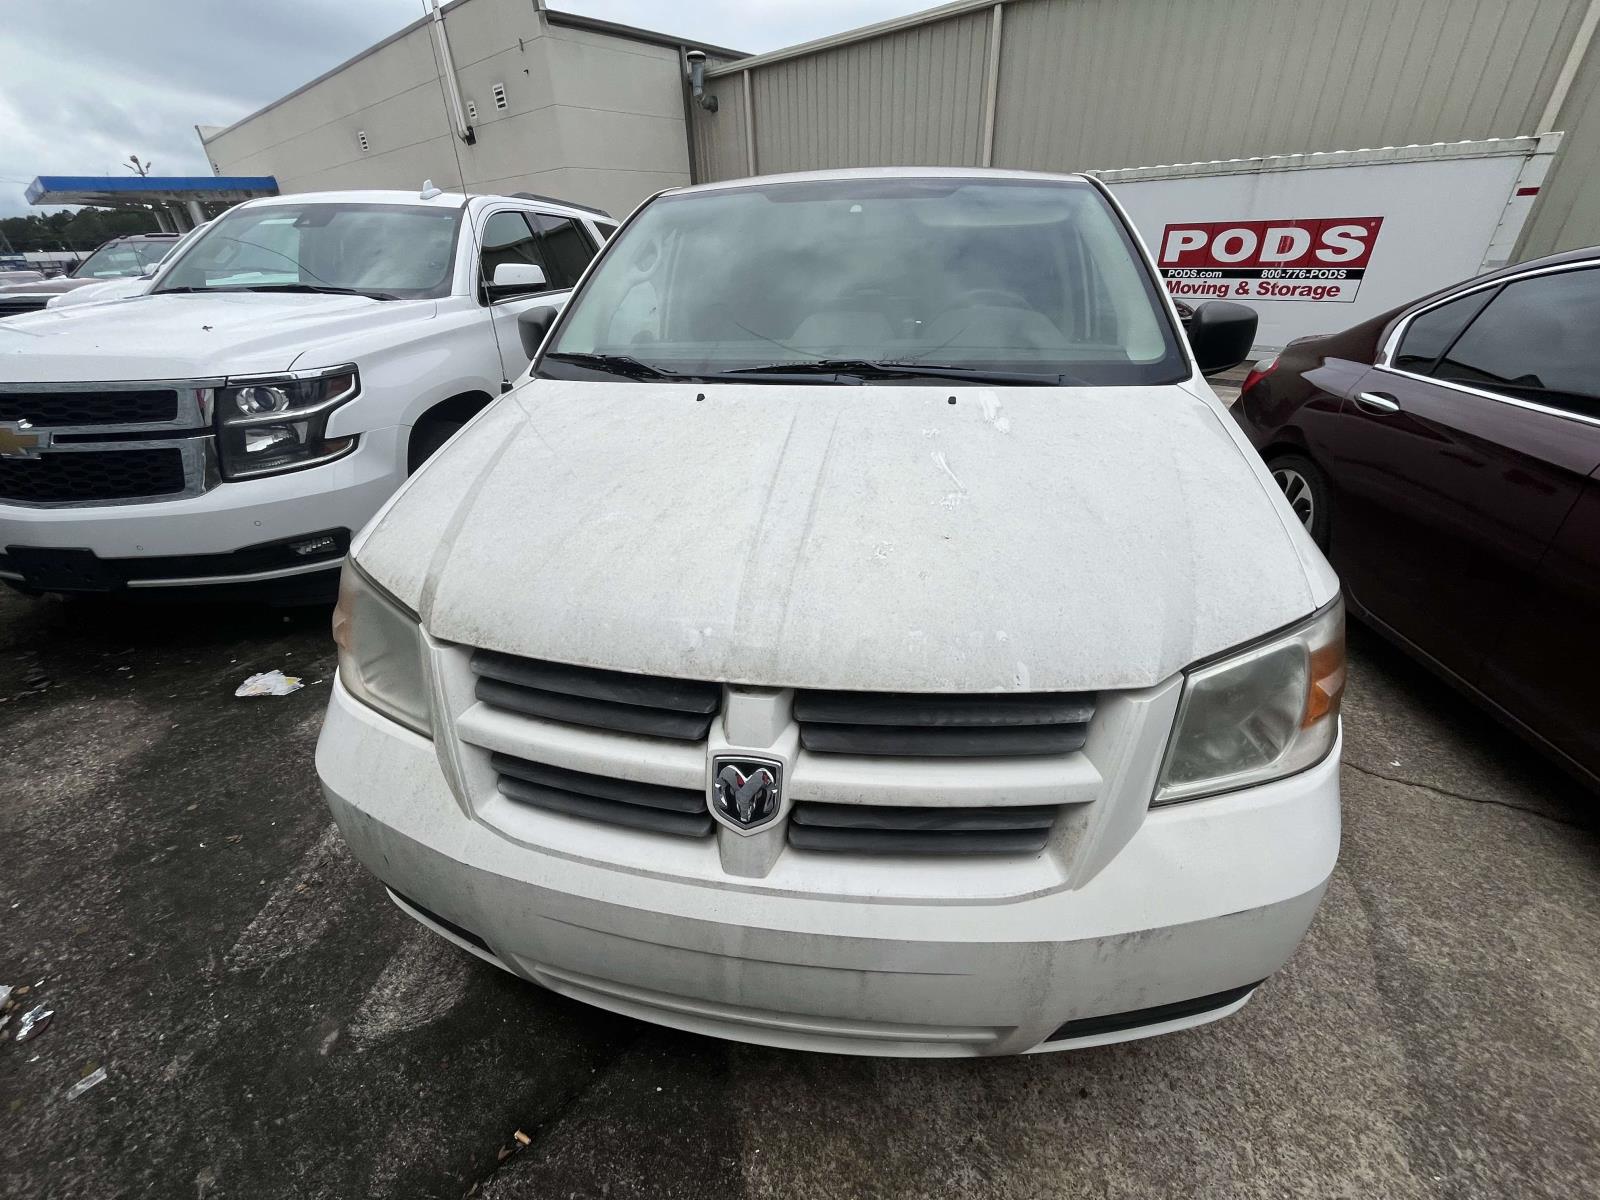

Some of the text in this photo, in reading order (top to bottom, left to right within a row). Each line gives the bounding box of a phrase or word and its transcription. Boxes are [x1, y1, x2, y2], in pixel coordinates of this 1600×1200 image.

[1163, 225, 1368, 263] PODS
[1167, 269, 1347, 279] PODS.com 800-776-PODS
[1166, 280, 1341, 300] Moving & Storage
